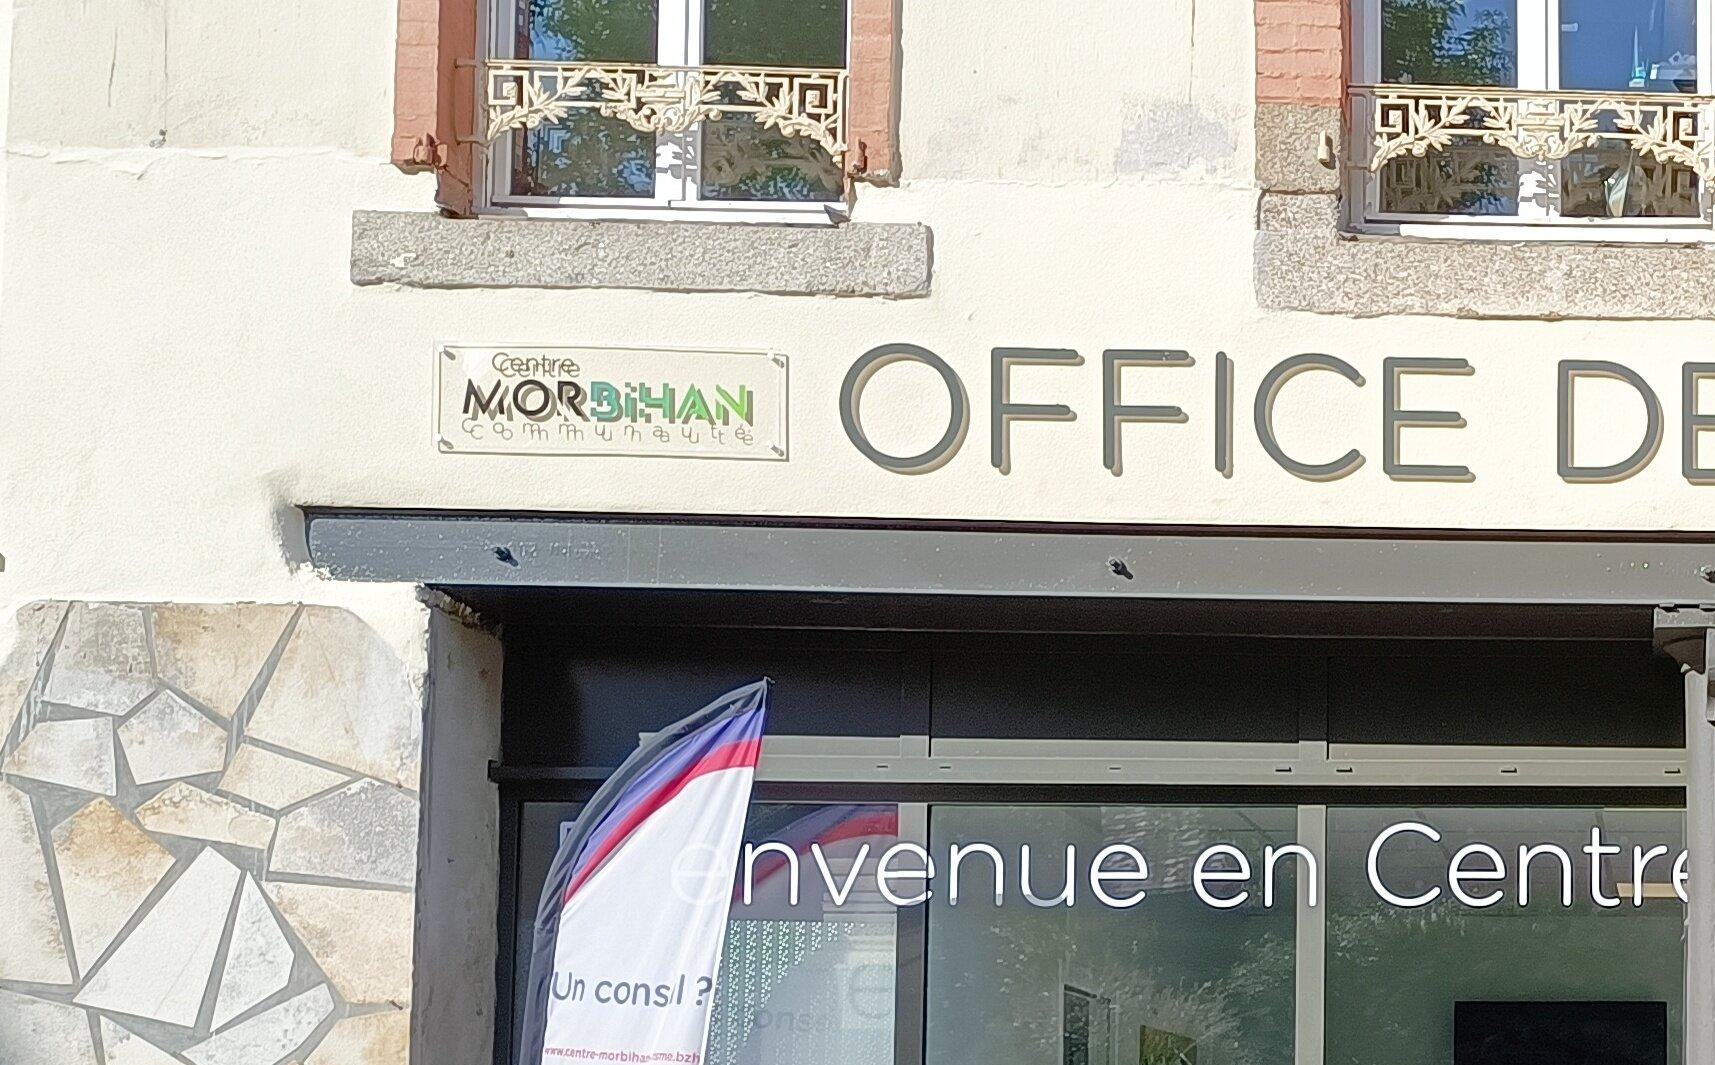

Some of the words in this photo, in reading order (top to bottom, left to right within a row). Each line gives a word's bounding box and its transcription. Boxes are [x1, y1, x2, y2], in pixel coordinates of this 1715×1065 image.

[492, 352, 578, 376] Centre
[838, 342, 1472, 479] OFFICE
[1192, 842, 1318, 909] en
[1366, 820, 1689, 909] Centr
[551, 970, 586, 1002] Un
[695, 975, 714, 1007] ?
